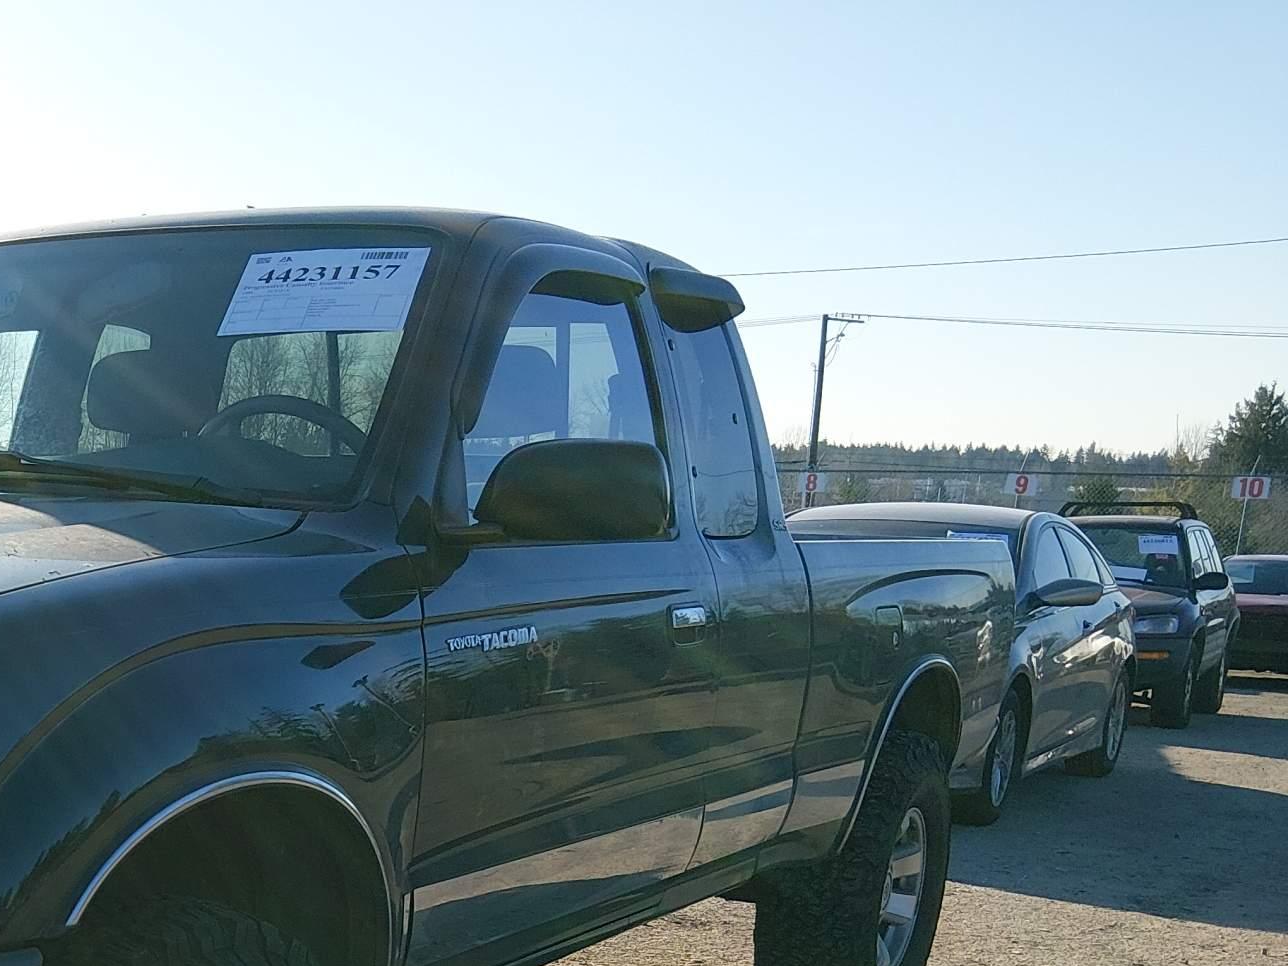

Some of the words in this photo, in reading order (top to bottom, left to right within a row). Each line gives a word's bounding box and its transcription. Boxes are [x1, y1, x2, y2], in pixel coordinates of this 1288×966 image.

[258, 264, 400, 284] 44231157
[805, 474, 817, 491] 8
[1015, 475, 1029, 494] 9
[1239, 478, 1264, 497] 10
[447, 635, 481, 652] TOYOTA
[479, 626, 538, 652] TACOMA
